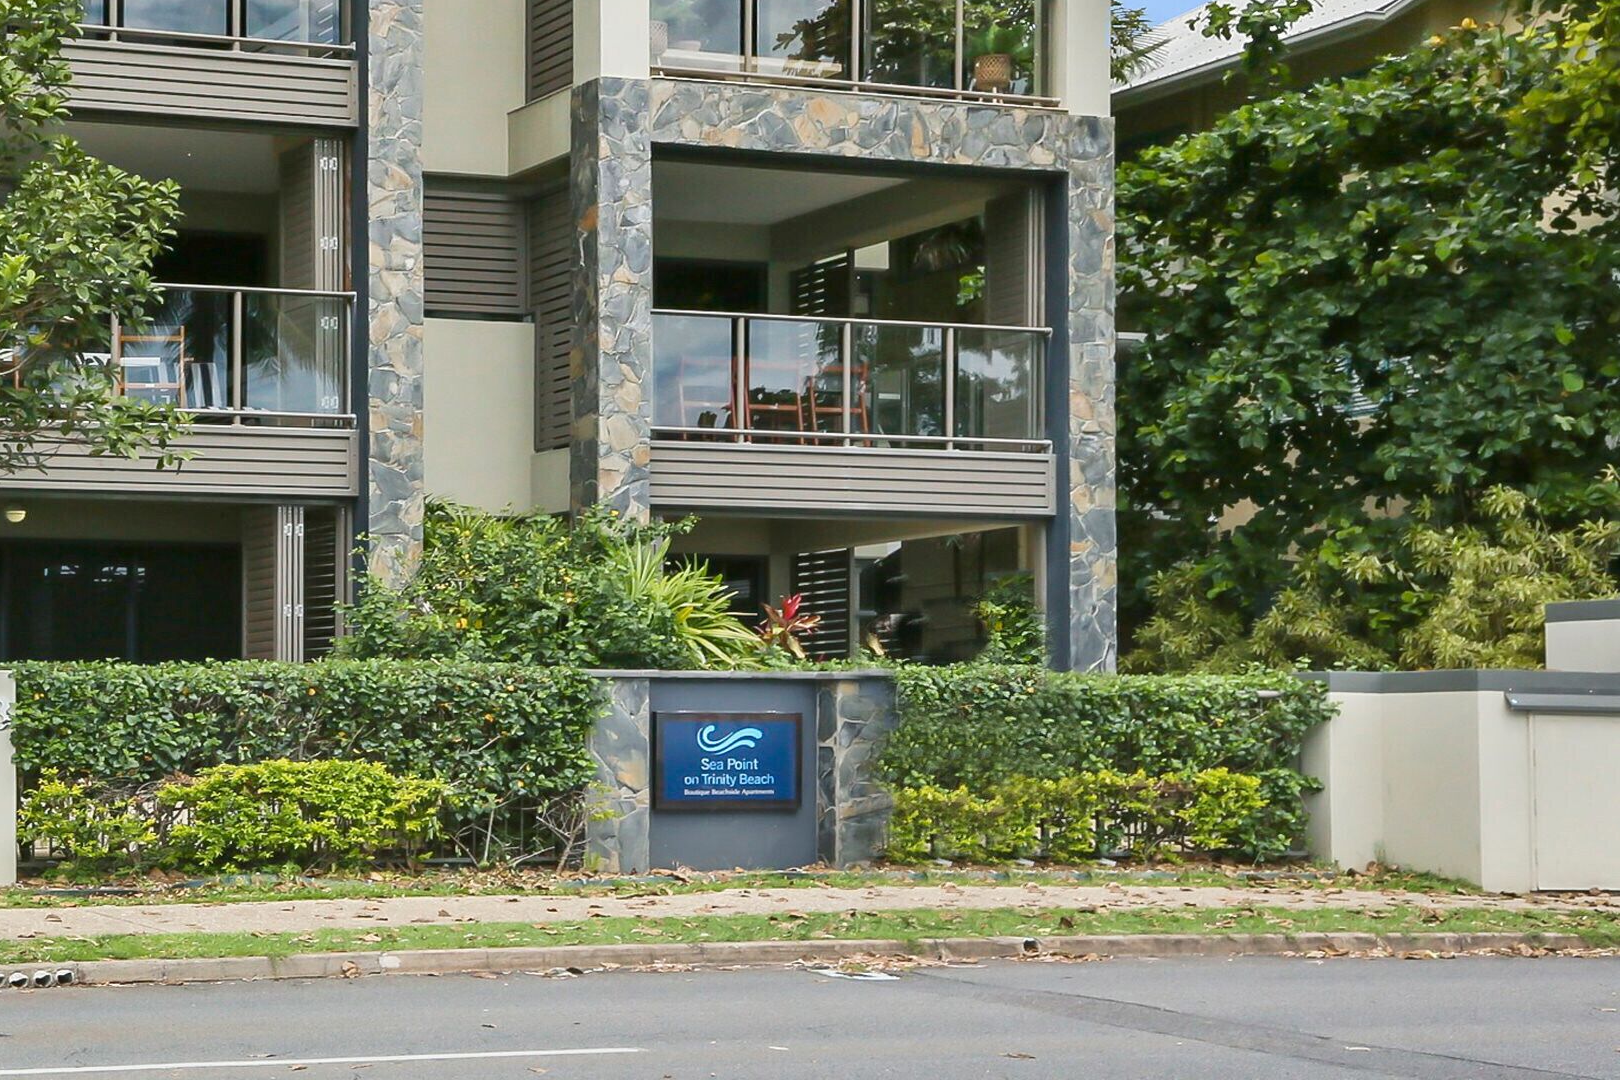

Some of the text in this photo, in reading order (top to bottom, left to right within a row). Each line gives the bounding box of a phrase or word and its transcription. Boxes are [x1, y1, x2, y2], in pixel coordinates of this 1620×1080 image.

[700, 758, 759, 770] Sea Point
[684, 773, 775, 787] on Trinity Beach
